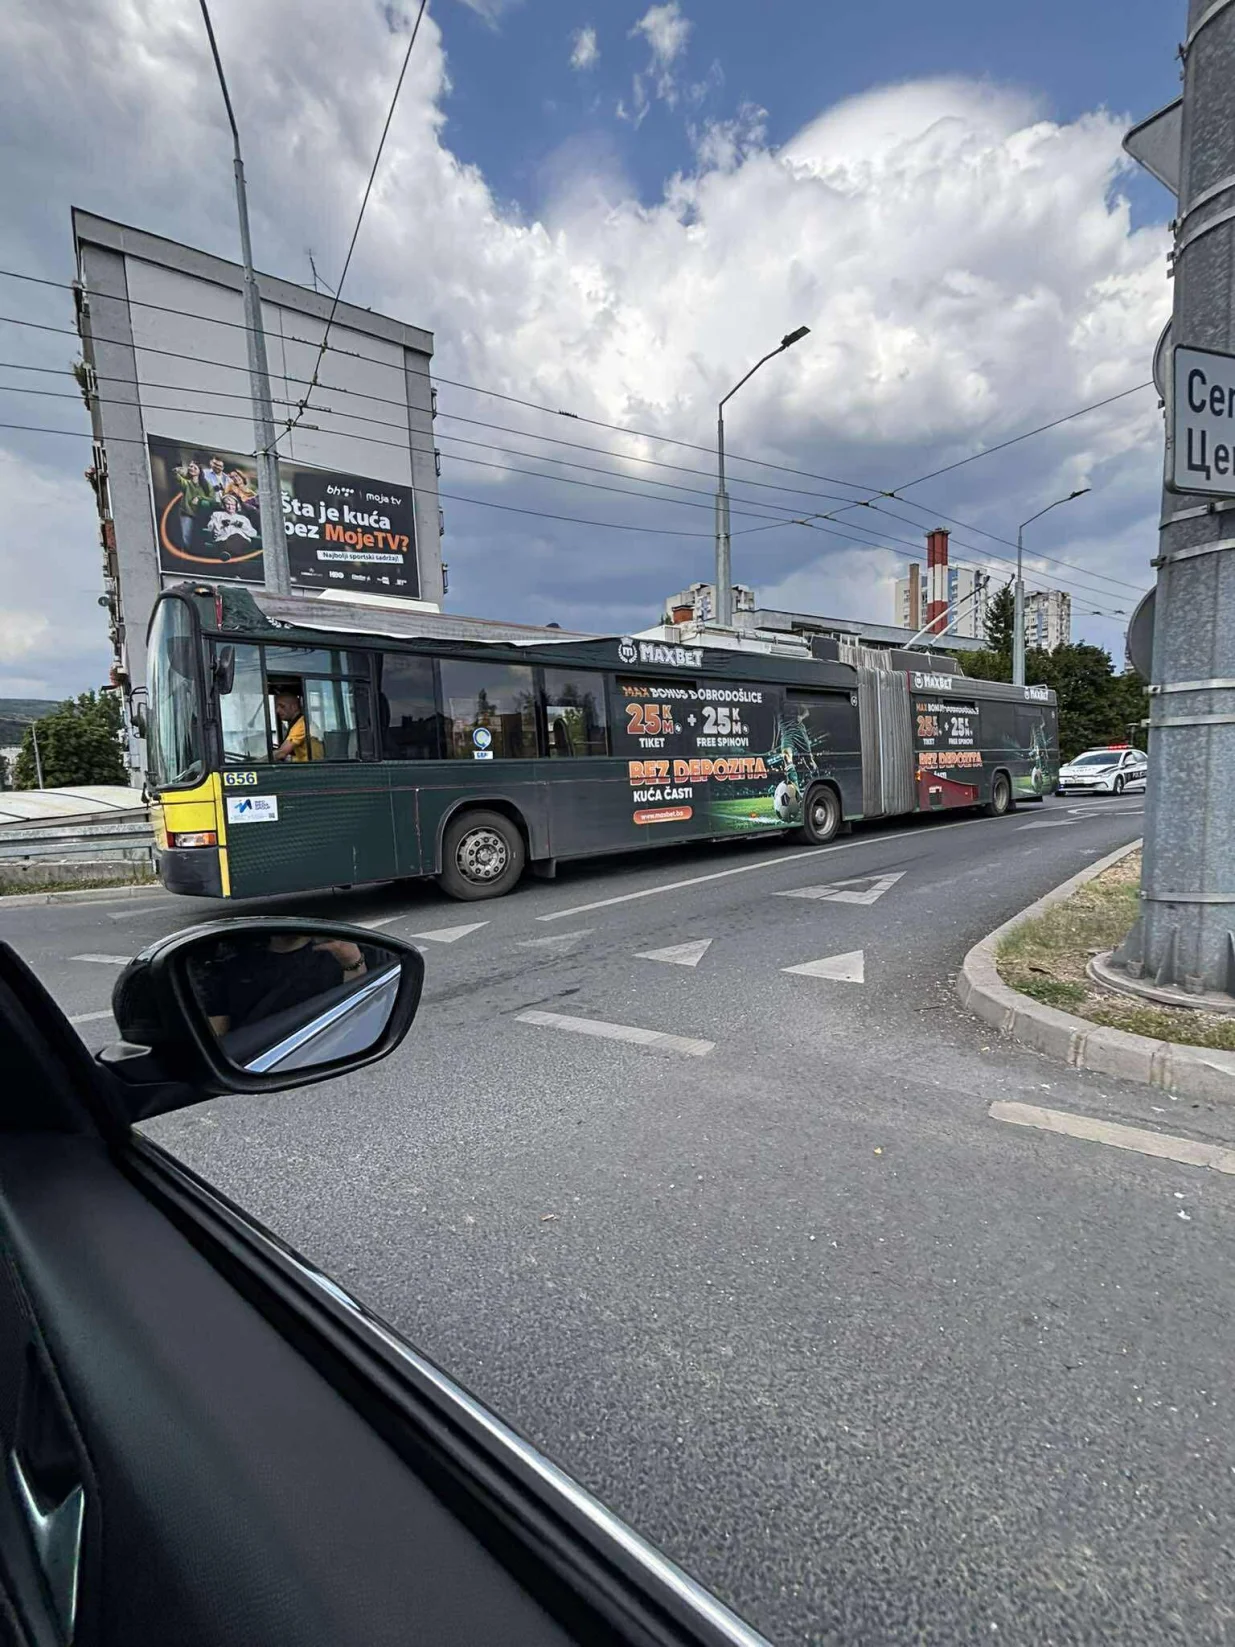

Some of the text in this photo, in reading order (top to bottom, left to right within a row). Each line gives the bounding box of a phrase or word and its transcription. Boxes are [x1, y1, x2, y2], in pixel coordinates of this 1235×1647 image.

[1187, 428, 1235, 481] Це
[281, 491, 391, 530] Šta je kuća
[390, 496, 402, 506] tv
[283, 516, 410, 552] bez MojeTV?
[322, 551, 349, 560] Najbolji
[349, 553, 375, 562] sportski
[622, 685, 763, 704] MAX BONUS DOBRODOŠLICE
[625, 702, 662, 735] 25
[701, 706, 731, 735] 25
[951, 717, 964, 737] 25
[639, 738, 665, 748] TIKET
[696, 738, 749, 747] FREE SPINOVI
[226, 772, 255, 785] 656
[628, 757, 768, 786] BEZ DEPOZITA
[633, 785, 693, 802] KUĆA ČASTI
